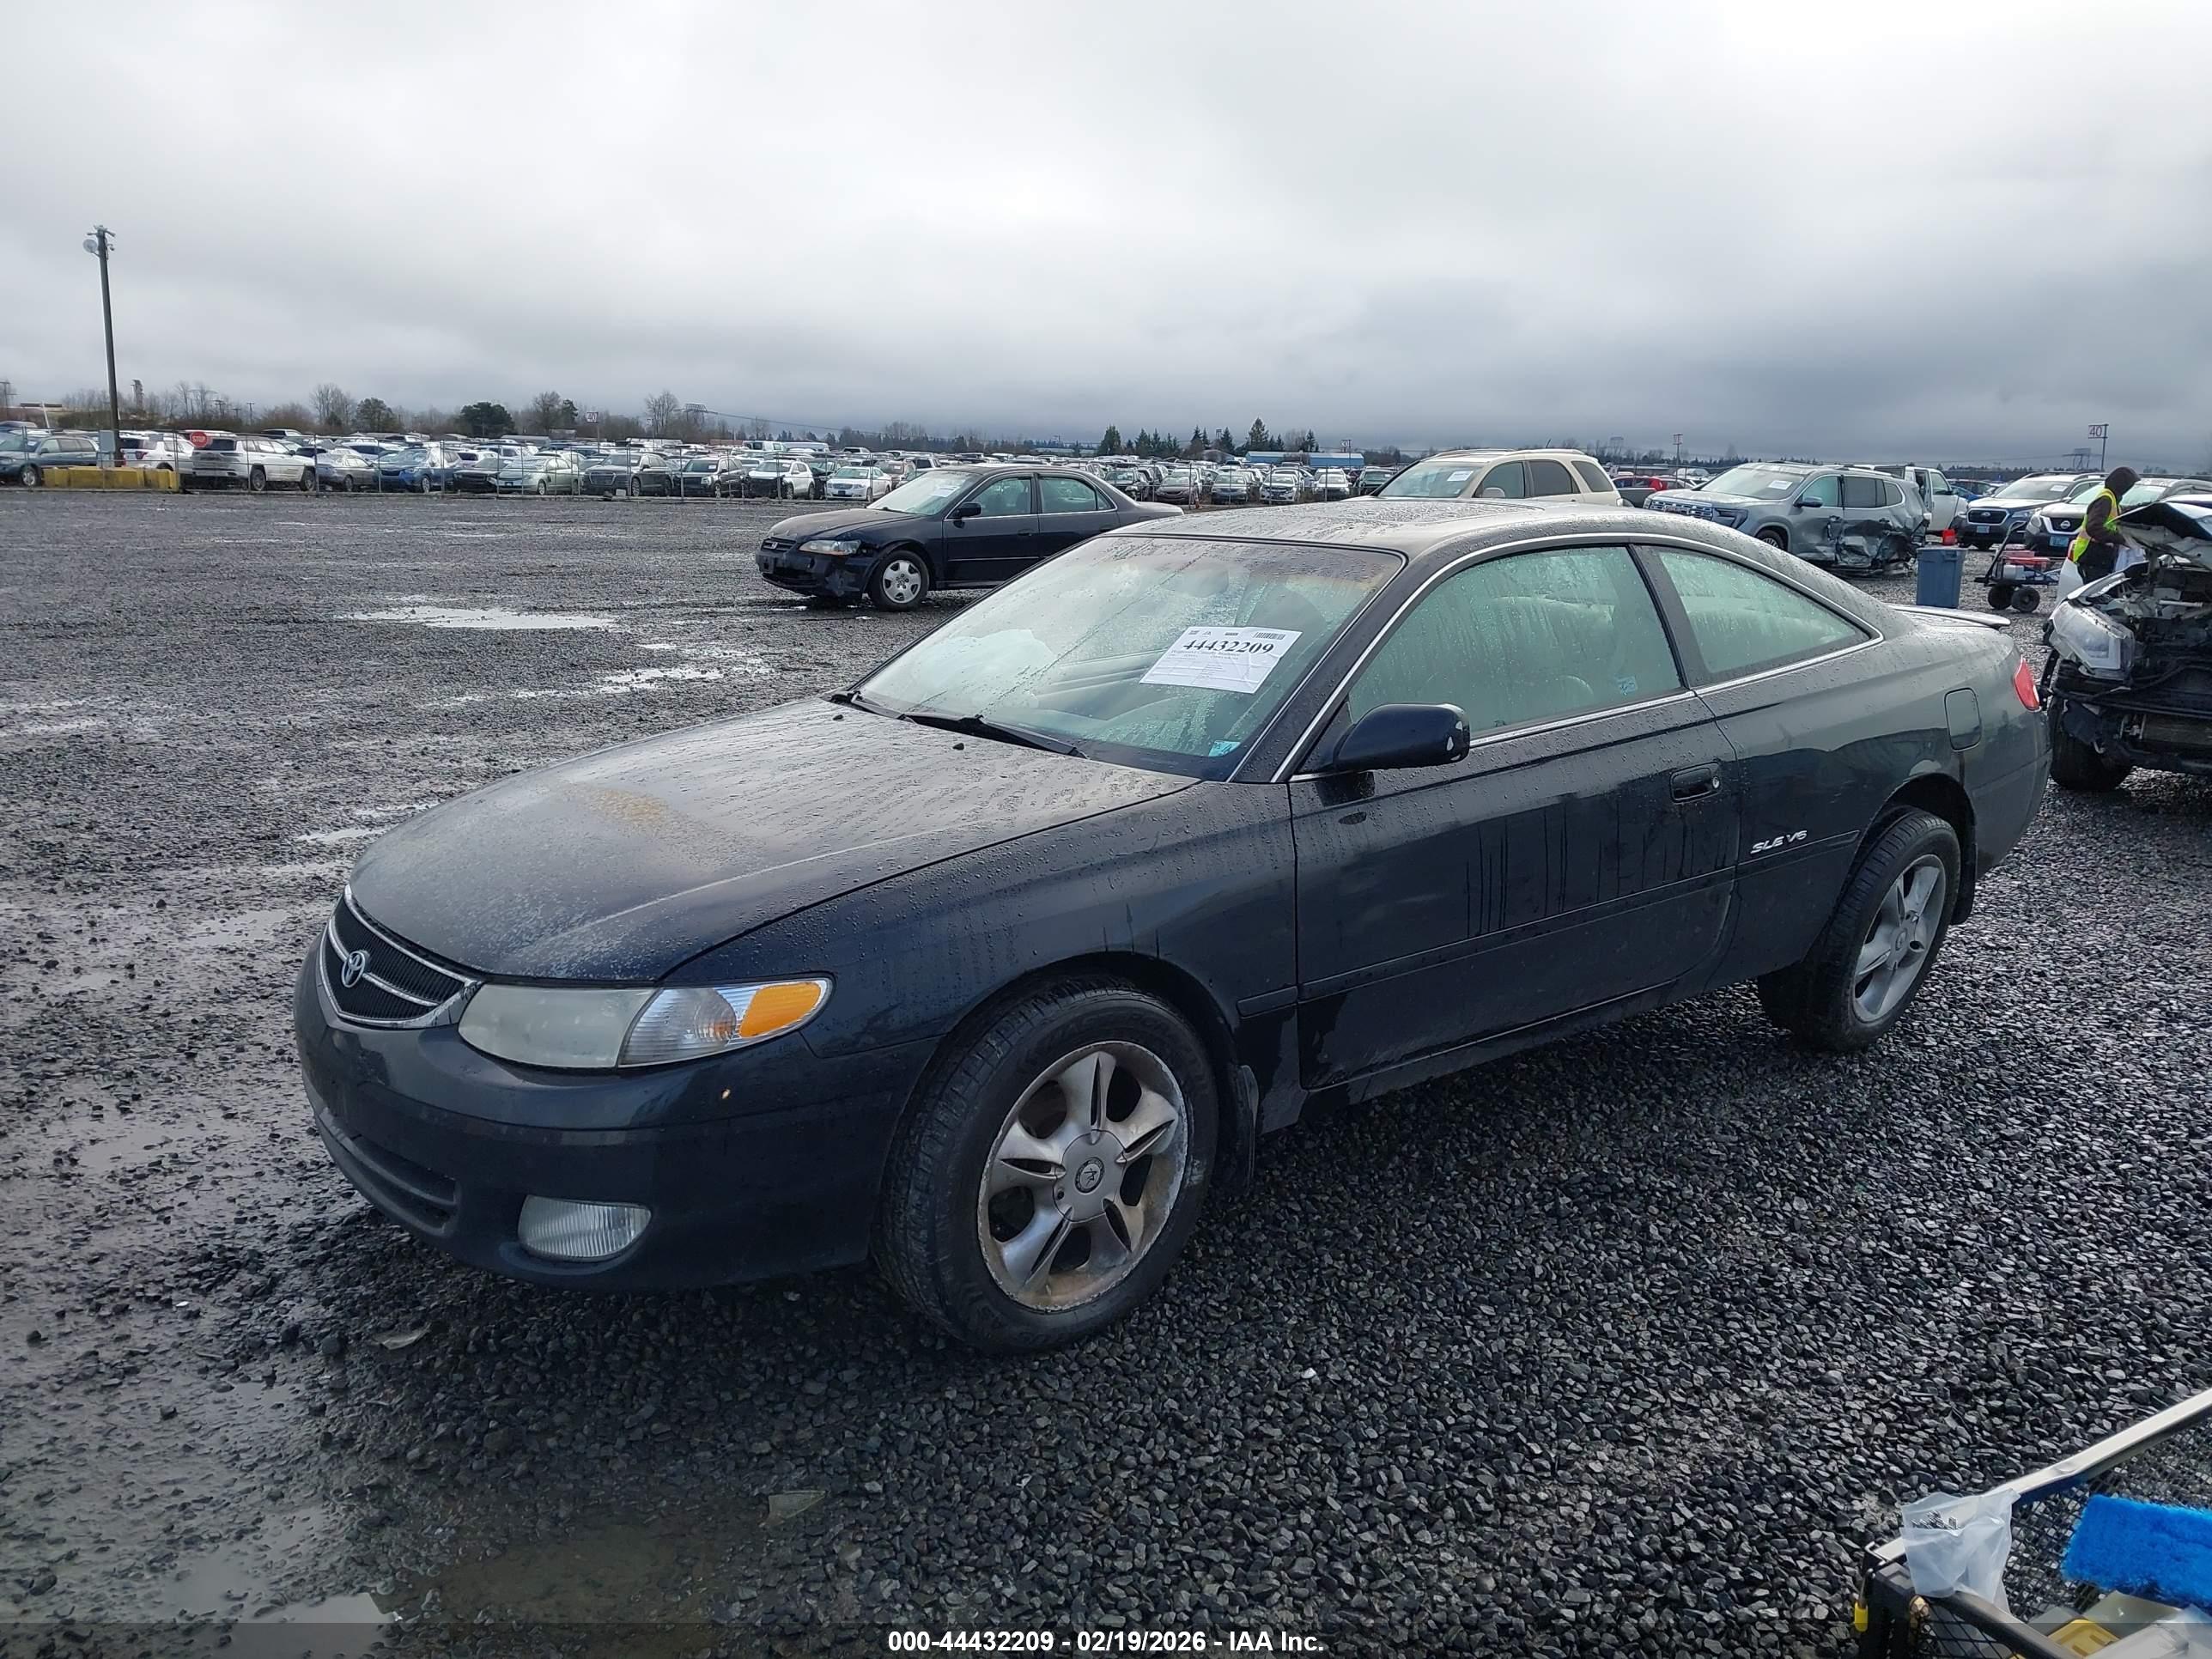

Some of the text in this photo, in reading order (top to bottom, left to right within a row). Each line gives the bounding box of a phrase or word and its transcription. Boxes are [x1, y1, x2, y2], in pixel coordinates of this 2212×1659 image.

[2089, 425, 2102, 437] 40
[1183, 639, 1274, 654] 44432209
[1750, 830, 1808, 854] SLE V6
